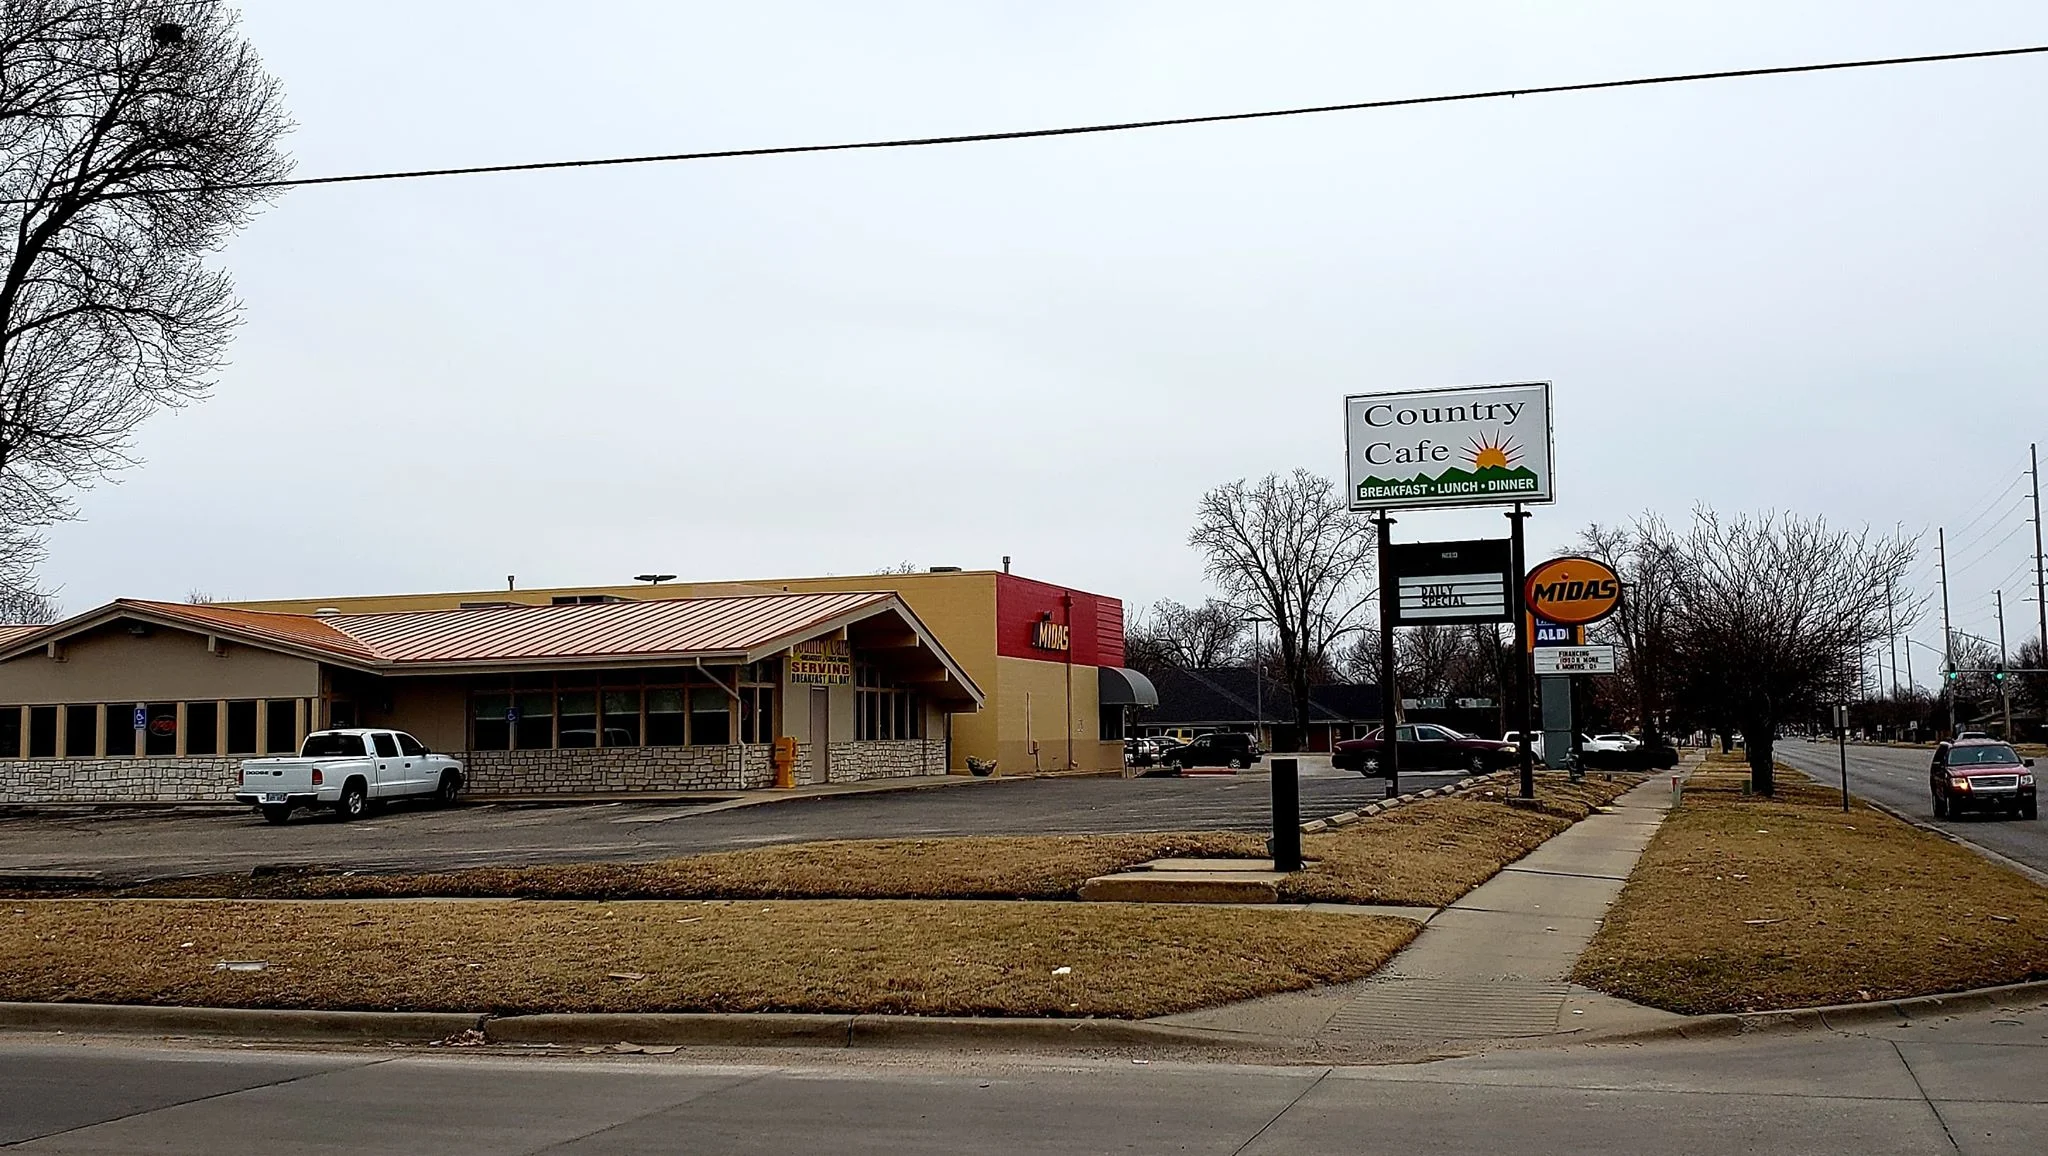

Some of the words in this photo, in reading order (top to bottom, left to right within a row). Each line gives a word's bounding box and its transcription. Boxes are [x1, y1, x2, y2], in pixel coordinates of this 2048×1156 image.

[1364, 401, 1525, 427] Country
[1364, 439, 1450, 465] Cafe
[1360, 484, 1428, 498] BREAKFAST
[1437, 481, 1478, 494] LUNCH
[1488, 478, 1535, 491] DINNER
[1421, 585, 1454, 596] DAILY
[1534, 573, 1617, 603] MIDAS
[1421, 595, 1466, 607] SPECIAL
[1039, 621, 1068, 651] MIDAS
[792, 662, 849, 675] SERVING
